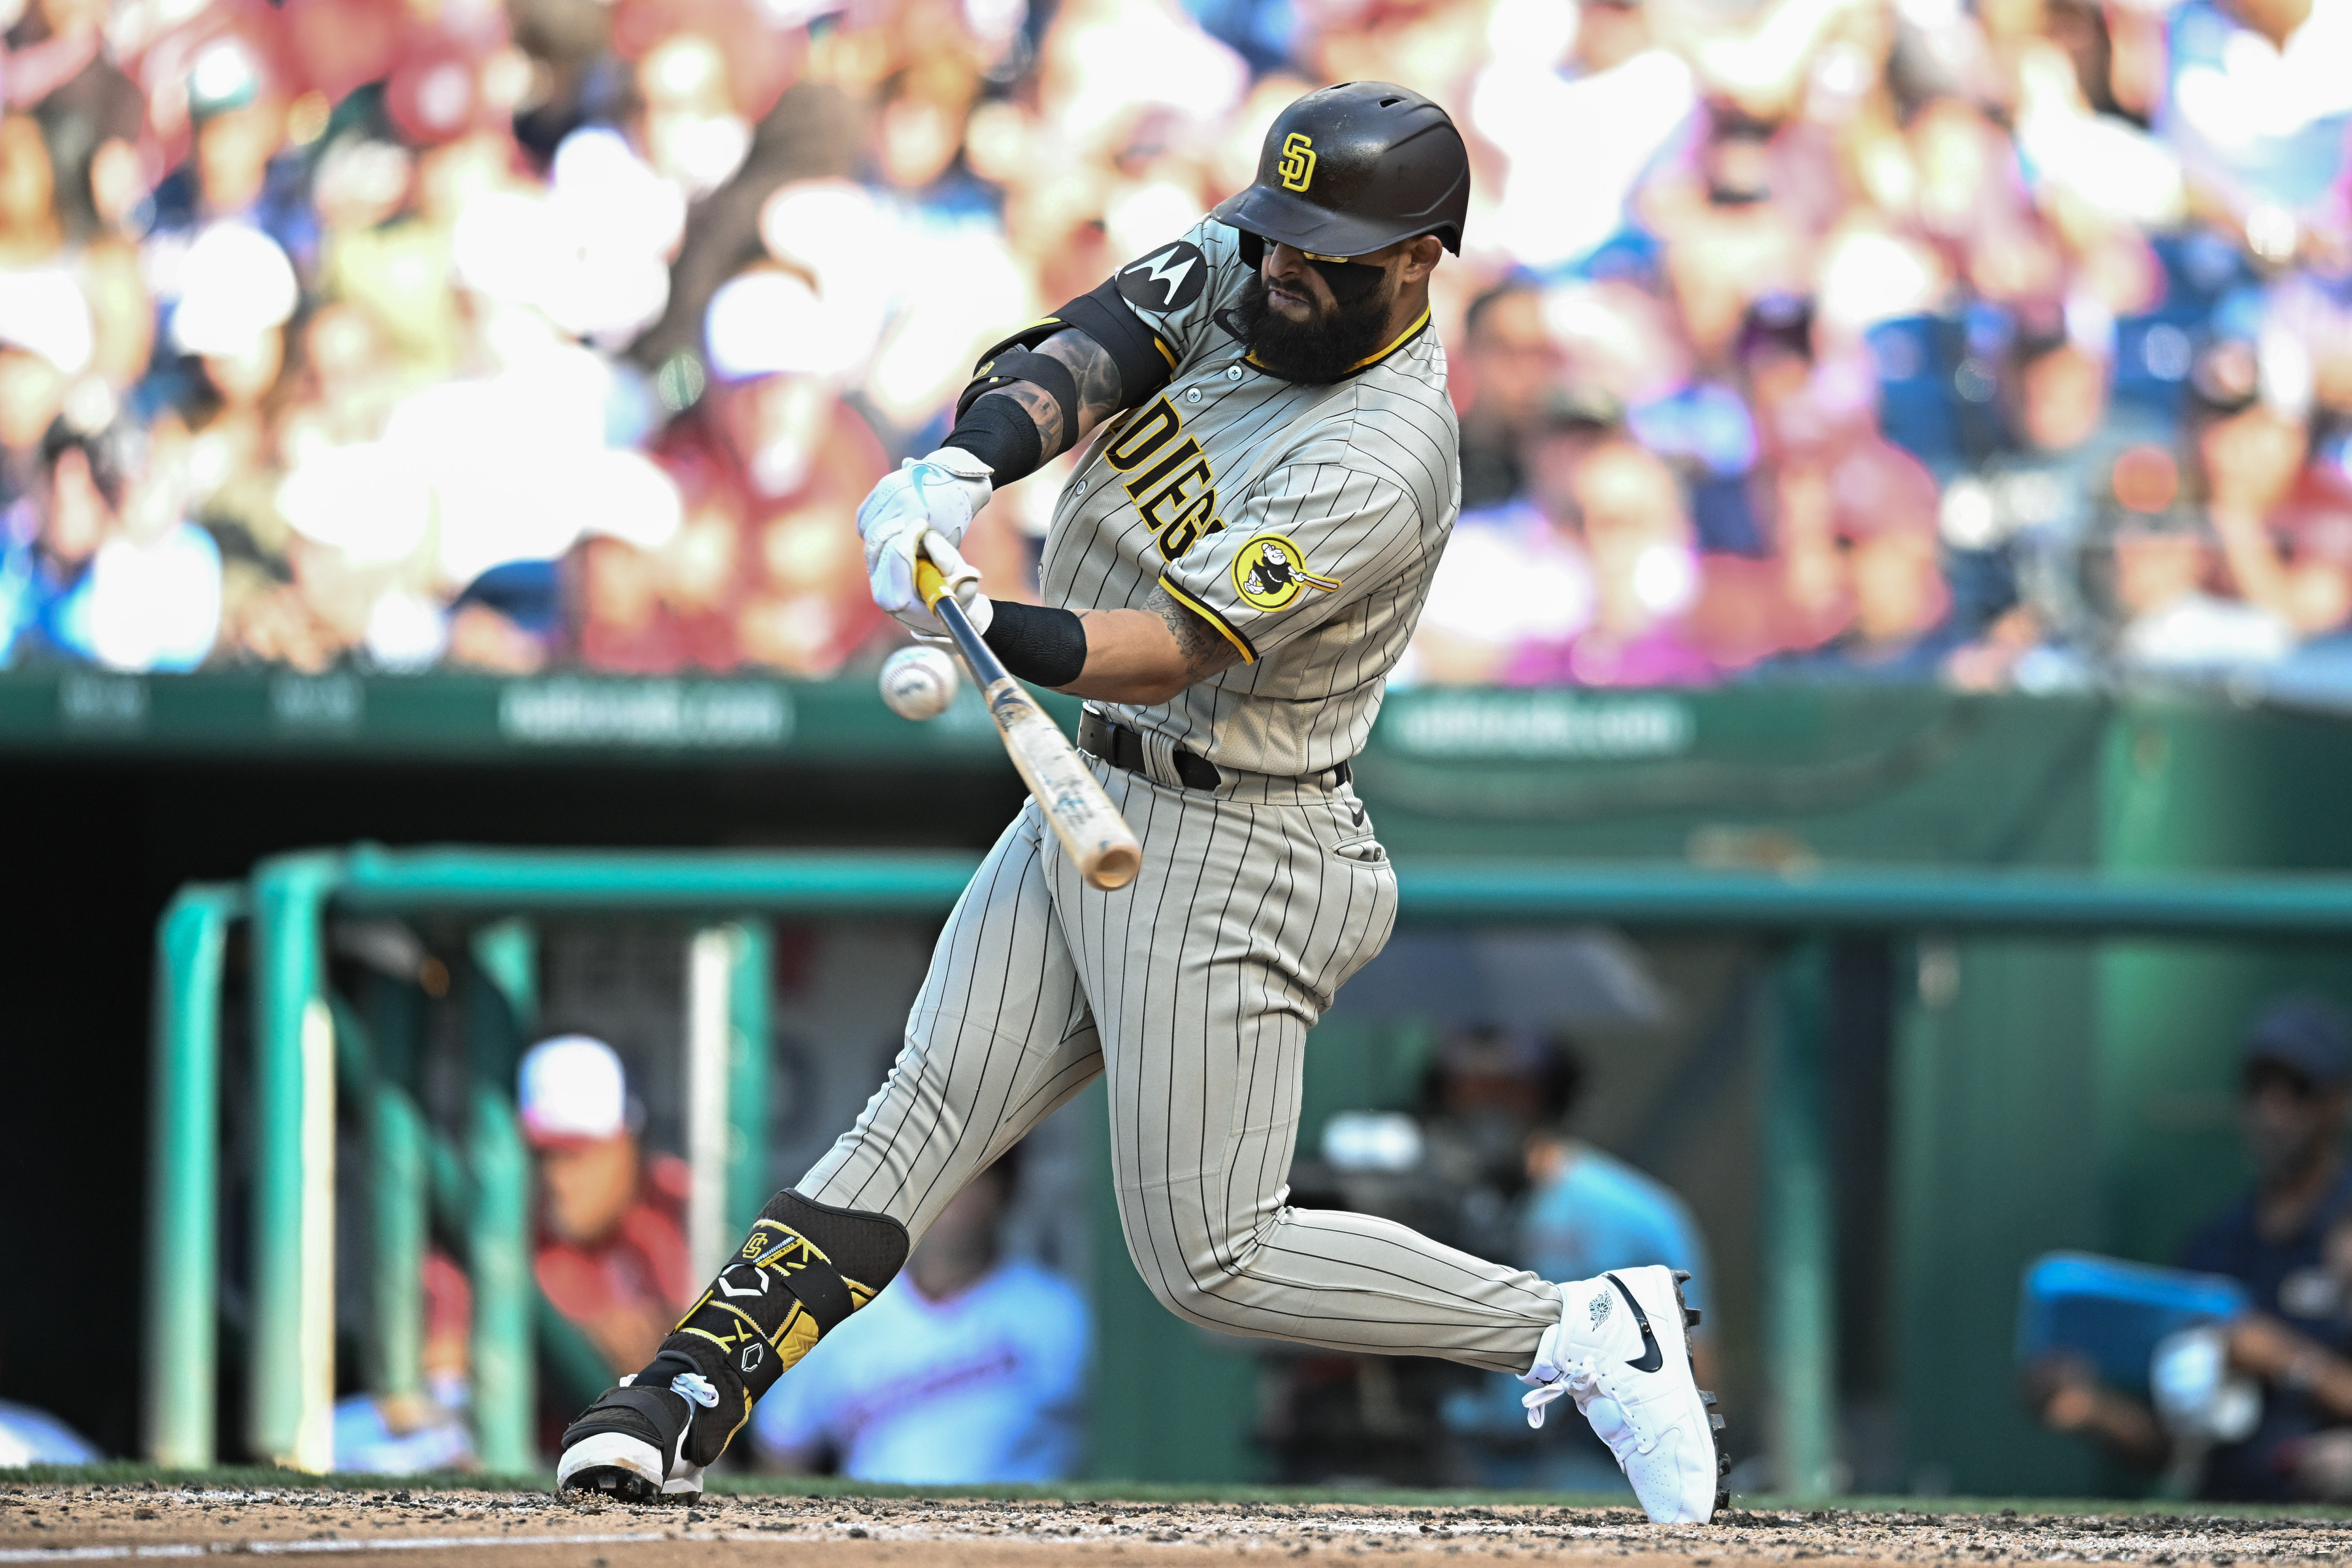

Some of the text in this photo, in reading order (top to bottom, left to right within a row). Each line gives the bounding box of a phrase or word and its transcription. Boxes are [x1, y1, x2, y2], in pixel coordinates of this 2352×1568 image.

[1278, 132, 1317, 193] SD
[1103, 392, 1227, 564] DIEG
[760, 1241, 798, 1265] EVOSHIELD
